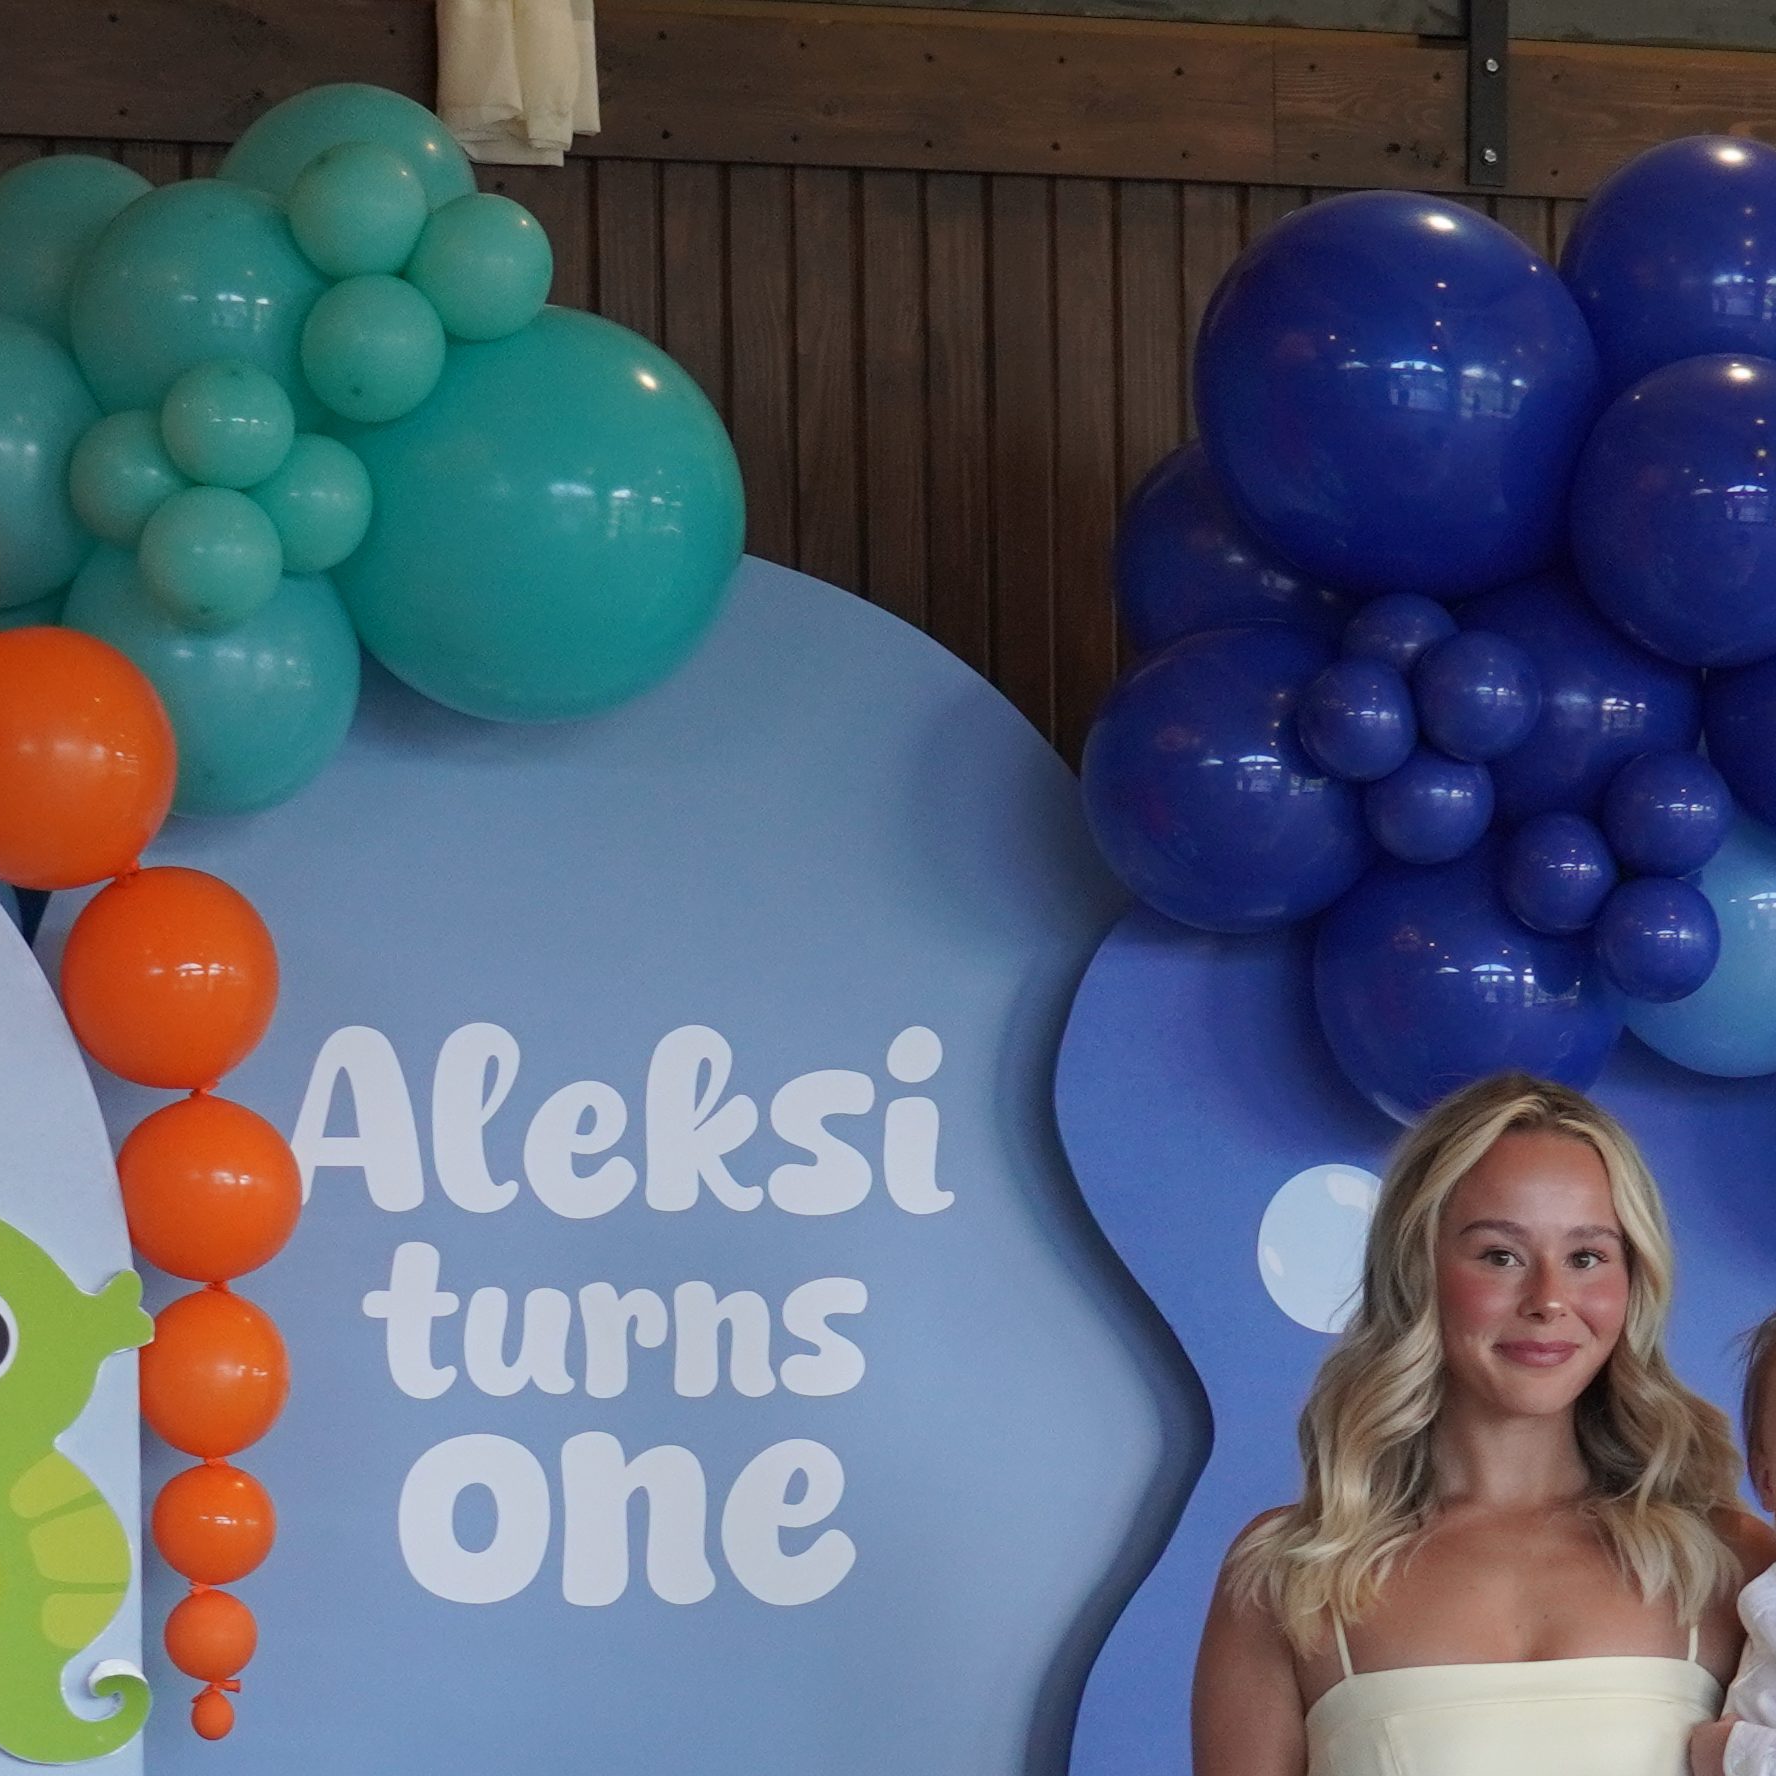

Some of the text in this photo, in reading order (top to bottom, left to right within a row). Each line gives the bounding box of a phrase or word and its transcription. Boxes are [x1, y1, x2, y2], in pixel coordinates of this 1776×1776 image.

[289, 1022, 955, 1219] Aleksi
[362, 1242, 868, 1399] turns
[398, 1431, 857, 1606] one
